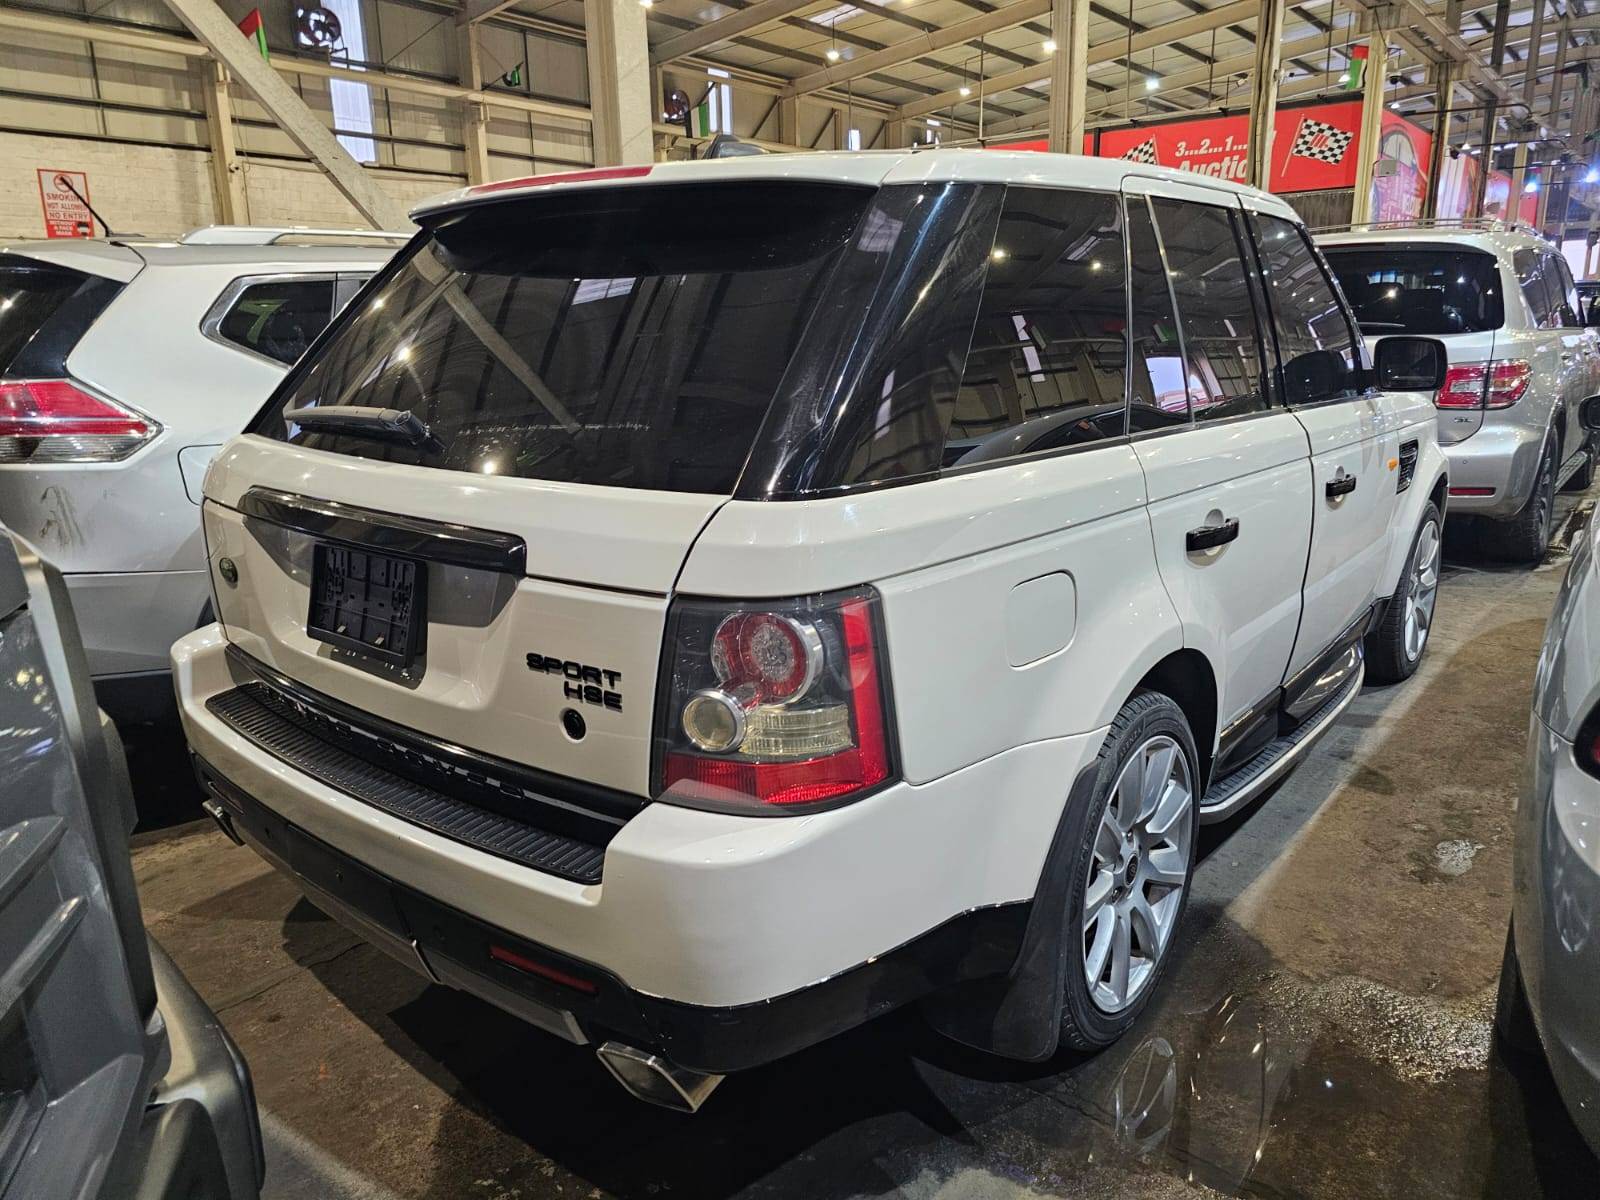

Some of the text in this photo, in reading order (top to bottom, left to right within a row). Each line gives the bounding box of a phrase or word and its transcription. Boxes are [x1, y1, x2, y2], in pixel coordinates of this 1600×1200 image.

[46, 193, 83, 202] SMOKIN
[526, 652, 622, 690] SPORT
[563, 680, 623, 712] HSE
